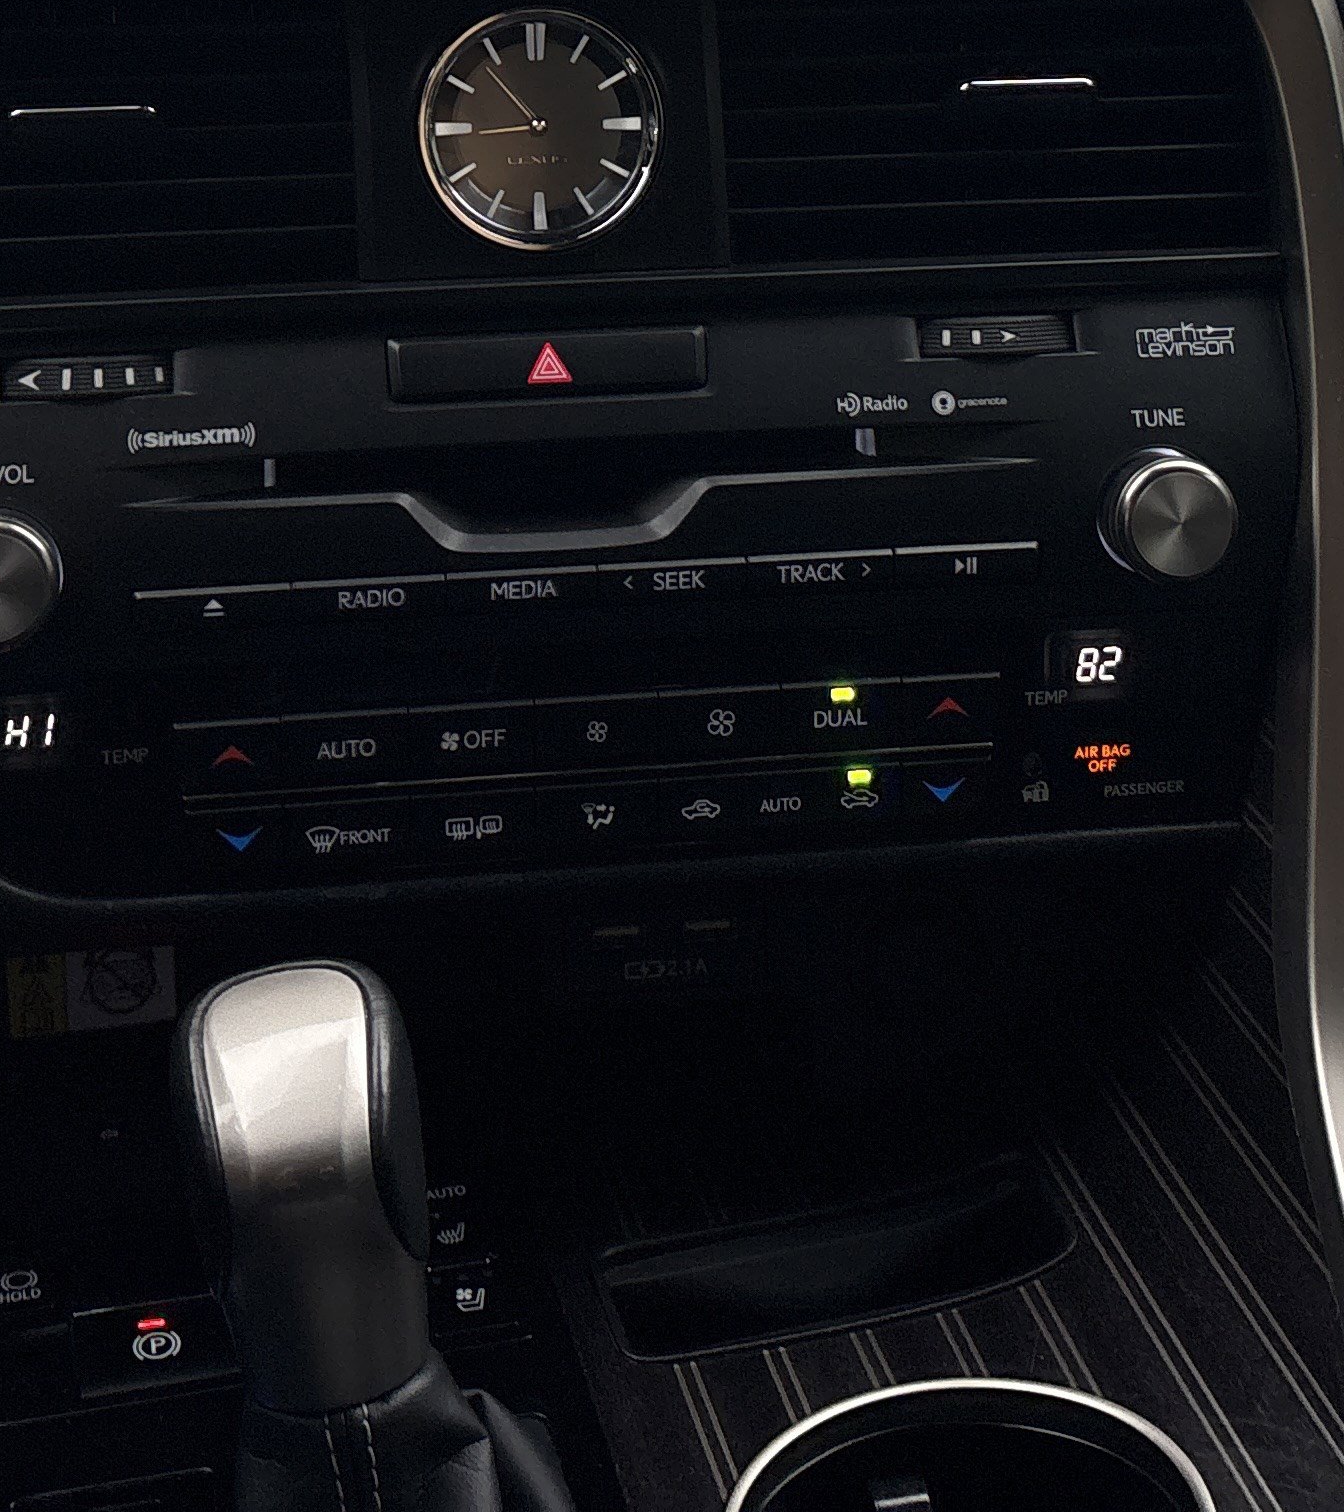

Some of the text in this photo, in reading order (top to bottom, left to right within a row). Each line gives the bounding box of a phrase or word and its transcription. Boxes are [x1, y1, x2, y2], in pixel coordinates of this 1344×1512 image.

[862, 394, 909, 412] Radio
[1130, 407, 1186, 429] TUNE
[652, 569, 706, 591] SEEK
[776, 562, 846, 584] TRACK
[337, 587, 405, 609] RADIO
[489, 578, 557, 601] MEDIA
[1075, 645, 1124, 683] 82
[1023, 689, 1068, 707] TEMP
[813, 710, 868, 729] DUAL
[317, 738, 376, 760] AUTO
[463, 729, 507, 750] OFF
[101, 747, 149, 767] TEMP
[1074, 743, 1132, 760] AIR BAG
[1087, 758, 1118, 774] OFF
[1103, 779, 1185, 798] PASSENGER
[759, 796, 802, 814] AUTO
[339, 827, 390, 845] FRONT
[0, 1287, 42, 1304] HOLD
